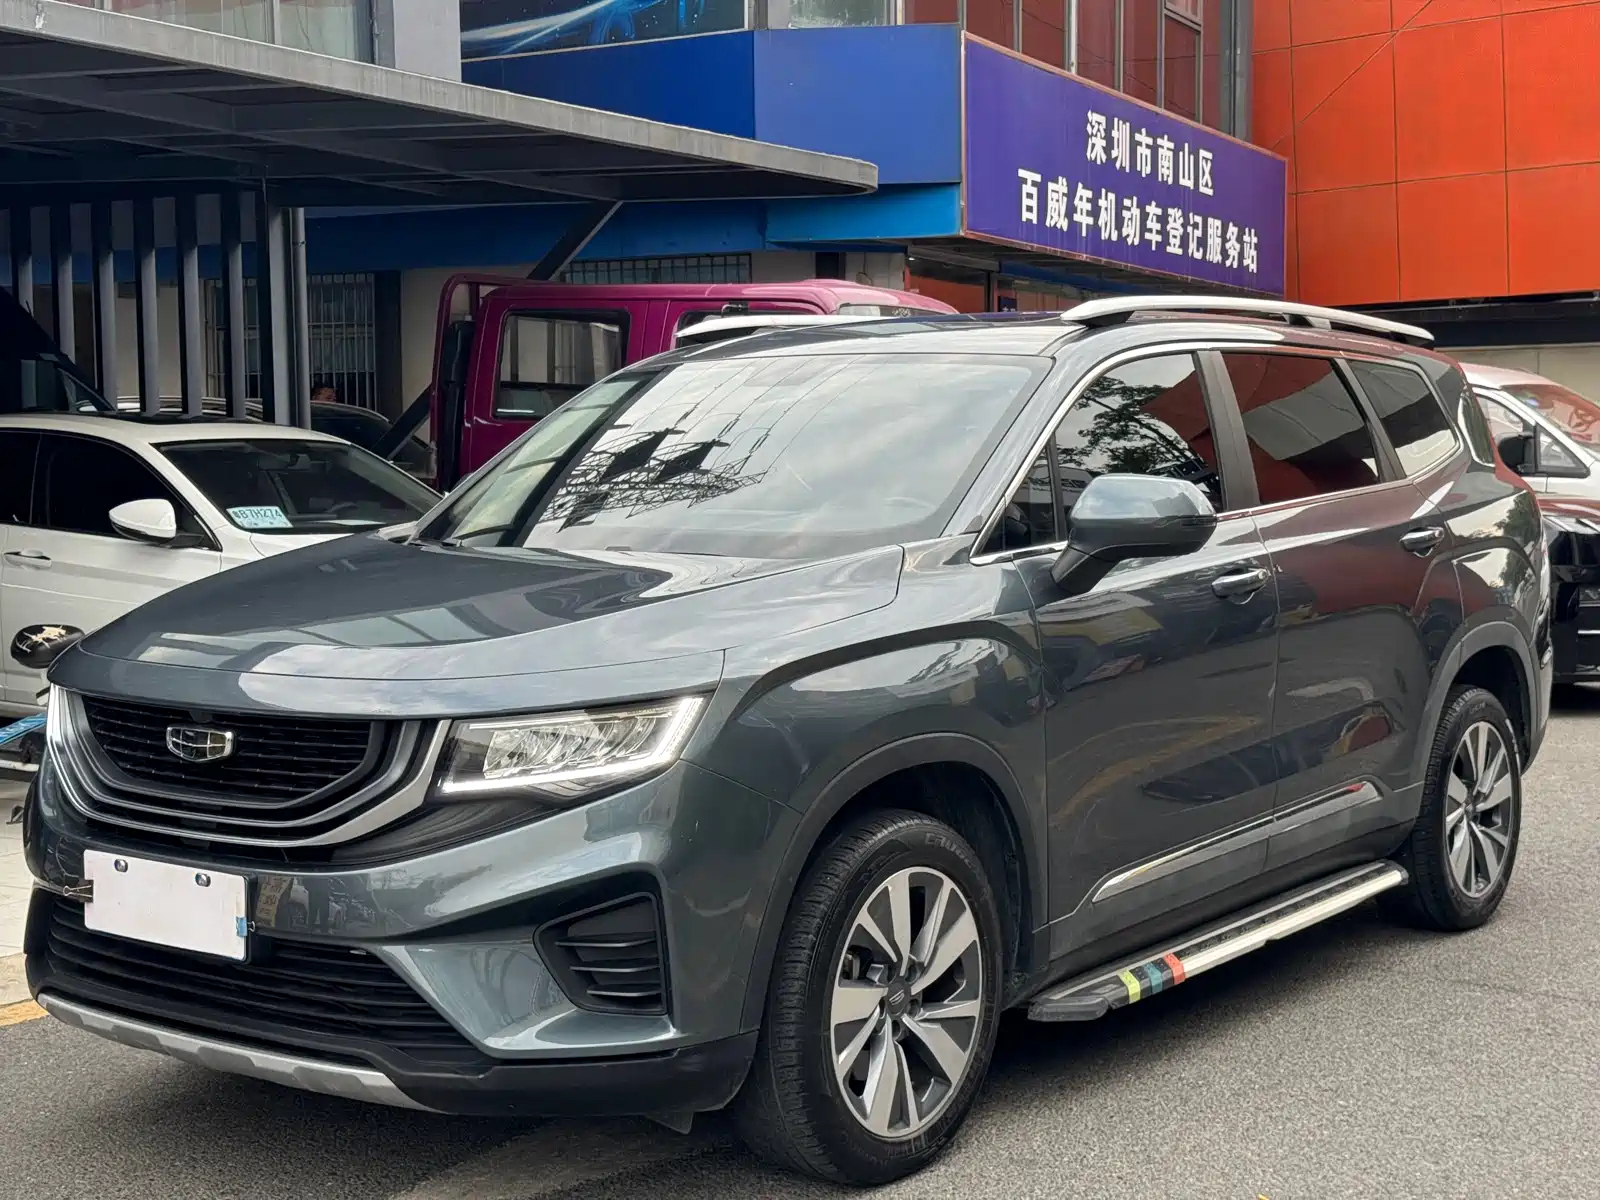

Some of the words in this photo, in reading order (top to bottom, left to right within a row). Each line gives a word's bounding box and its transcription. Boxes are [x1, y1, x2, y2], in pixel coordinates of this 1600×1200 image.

[1086, 109, 1214, 196] 深圳市南山区
[1017, 168, 1258, 273] 百威年机动车登记服务站
